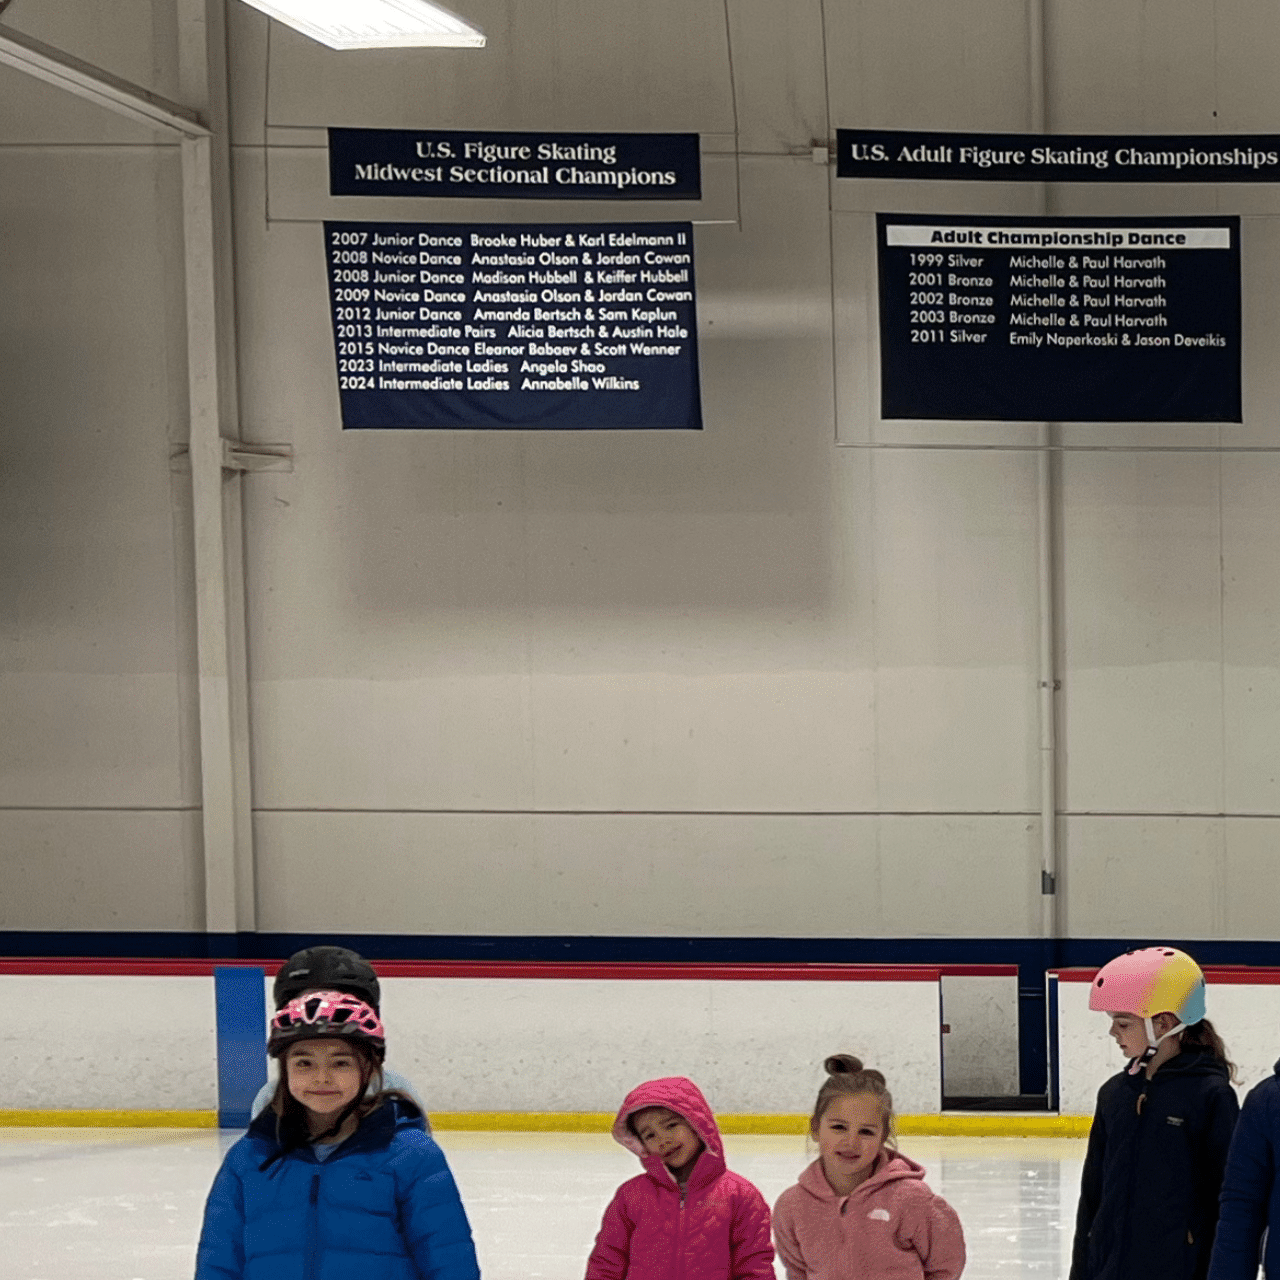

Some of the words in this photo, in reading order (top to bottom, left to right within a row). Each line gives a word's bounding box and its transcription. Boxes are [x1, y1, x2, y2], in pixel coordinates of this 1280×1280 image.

[416, 141, 456, 159] U.S.
[464, 141, 531, 163] Figure
[537, 142, 617, 164] Skating
[851, 144, 889, 161] U.S.
[896, 144, 953, 163] Adult
[959, 146, 1026, 168] Figure
[1030, 146, 1109, 169] Skating
[1114, 147, 1279, 169] Championships
[355, 162, 443, 182] Midwest
[449, 165, 549, 184] Sectional
[555, 166, 676, 189] Champions
[331, 231, 368, 246] 2007
[371, 232, 415, 247] Junior
[418, 233, 463, 247] Dance
[470, 233, 517, 248] Brooke
[520, 233, 562, 248] Huber
[564, 233, 576, 247] &
[578, 233, 605, 247] Karl
[608, 232, 674, 247] Edelmann
[930, 230, 983, 245] Adult
[986, 231, 1124, 247] Championship
[1127, 232, 1187, 246] Dance
[332, 250, 368, 265] 2008
[371, 251, 418, 265] Novice
[419, 251, 462, 266] Dance
[471, 252, 536, 266] Anastasia
[538, 251, 579, 266] Olson
[581, 251, 593, 266] &
[596, 251, 641, 266] Jordan
[643, 250, 691, 265] Cowan
[910, 253, 944, 267] 1999
[947, 253, 984, 268] Silver
[1009, 255, 1065, 269] Michelle
[1068, 255, 1079, 269] &
[1082, 255, 1110, 269] Paul
[333, 269, 369, 283] 2008
[372, 269, 417, 284] Junior
[419, 270, 465, 284] Dance
[471, 270, 526, 285] Madison
[528, 269, 578, 285] Hubbell
[583, 270, 594, 284] &
[640, 269, 689, 284] Hubbell
[908, 272, 942, 286] 2001
[947, 273, 994, 287] Bronze
[1009, 273, 1066, 288] Michelle
[1068, 275, 1079, 288] &
[1082, 274, 1110, 289] Paul
[334, 288, 371, 302] 2009
[374, 288, 420, 303] Novice
[423, 288, 466, 303] Dance
[472, 289, 538, 303] Anastasia
[540, 288, 582, 303] Olson
[584, 289, 595, 303] &
[597, 287, 644, 303] Jordan
[646, 288, 693, 302] Cowan
[909, 291, 944, 305] 2002
[948, 292, 994, 307] Bronze
[1010, 293, 1066, 307] Michelle
[1069, 294, 1080, 307] &
[1083, 293, 1111, 308] Paul
[335, 306, 371, 321] 2012
[375, 306, 417, 321] Junior
[419, 306, 462, 321] Dance
[473, 307, 531, 321] Amanda
[533, 307, 582, 322] Bertsch
[584, 307, 595, 321] &
[598, 307, 628, 321] Sam
[631, 306, 678, 324] Kaplun
[909, 309, 945, 324] 2003
[949, 310, 996, 324] Bronze
[1009, 312, 1066, 327] Michelle
[1069, 313, 1080, 327] &
[1083, 313, 1112, 328] Paul
[336, 324, 373, 338] 2013
[376, 324, 462, 339] Intermediate
[464, 324, 497, 339] Pairs
[507, 324, 544, 339] Alicia
[547, 324, 595, 339] Bertsch
[598, 324, 609, 339] &
[611, 325, 654, 339] Austin
[656, 324, 688, 339] Hale
[910, 329, 944, 343] 2011
[949, 329, 988, 343] Silver
[1009, 331, 1044, 348] Emily
[1121, 333, 1131, 346] &
[1134, 333, 1171, 347] Jason
[338, 341, 375, 356] 2015
[378, 341, 424, 356] Novice
[427, 341, 471, 356] Dance
[474, 341, 525, 356] Eleanor
[580, 342, 591, 356] &
[594, 342, 627, 356] Scott
[629, 342, 682, 356] Wenner
[339, 358, 375, 373] 2023
[378, 358, 463, 373] Intermediate
[466, 358, 509, 373] Ladies
[520, 359, 568, 377] Angela
[570, 359, 606, 374] Shao
[340, 375, 375, 390] 2024
[379, 376, 464, 391] Intermediate
[466, 376, 510, 391] Ladies
[520, 376, 589, 391] Annabelle
[591, 376, 640, 391] Wilkins
